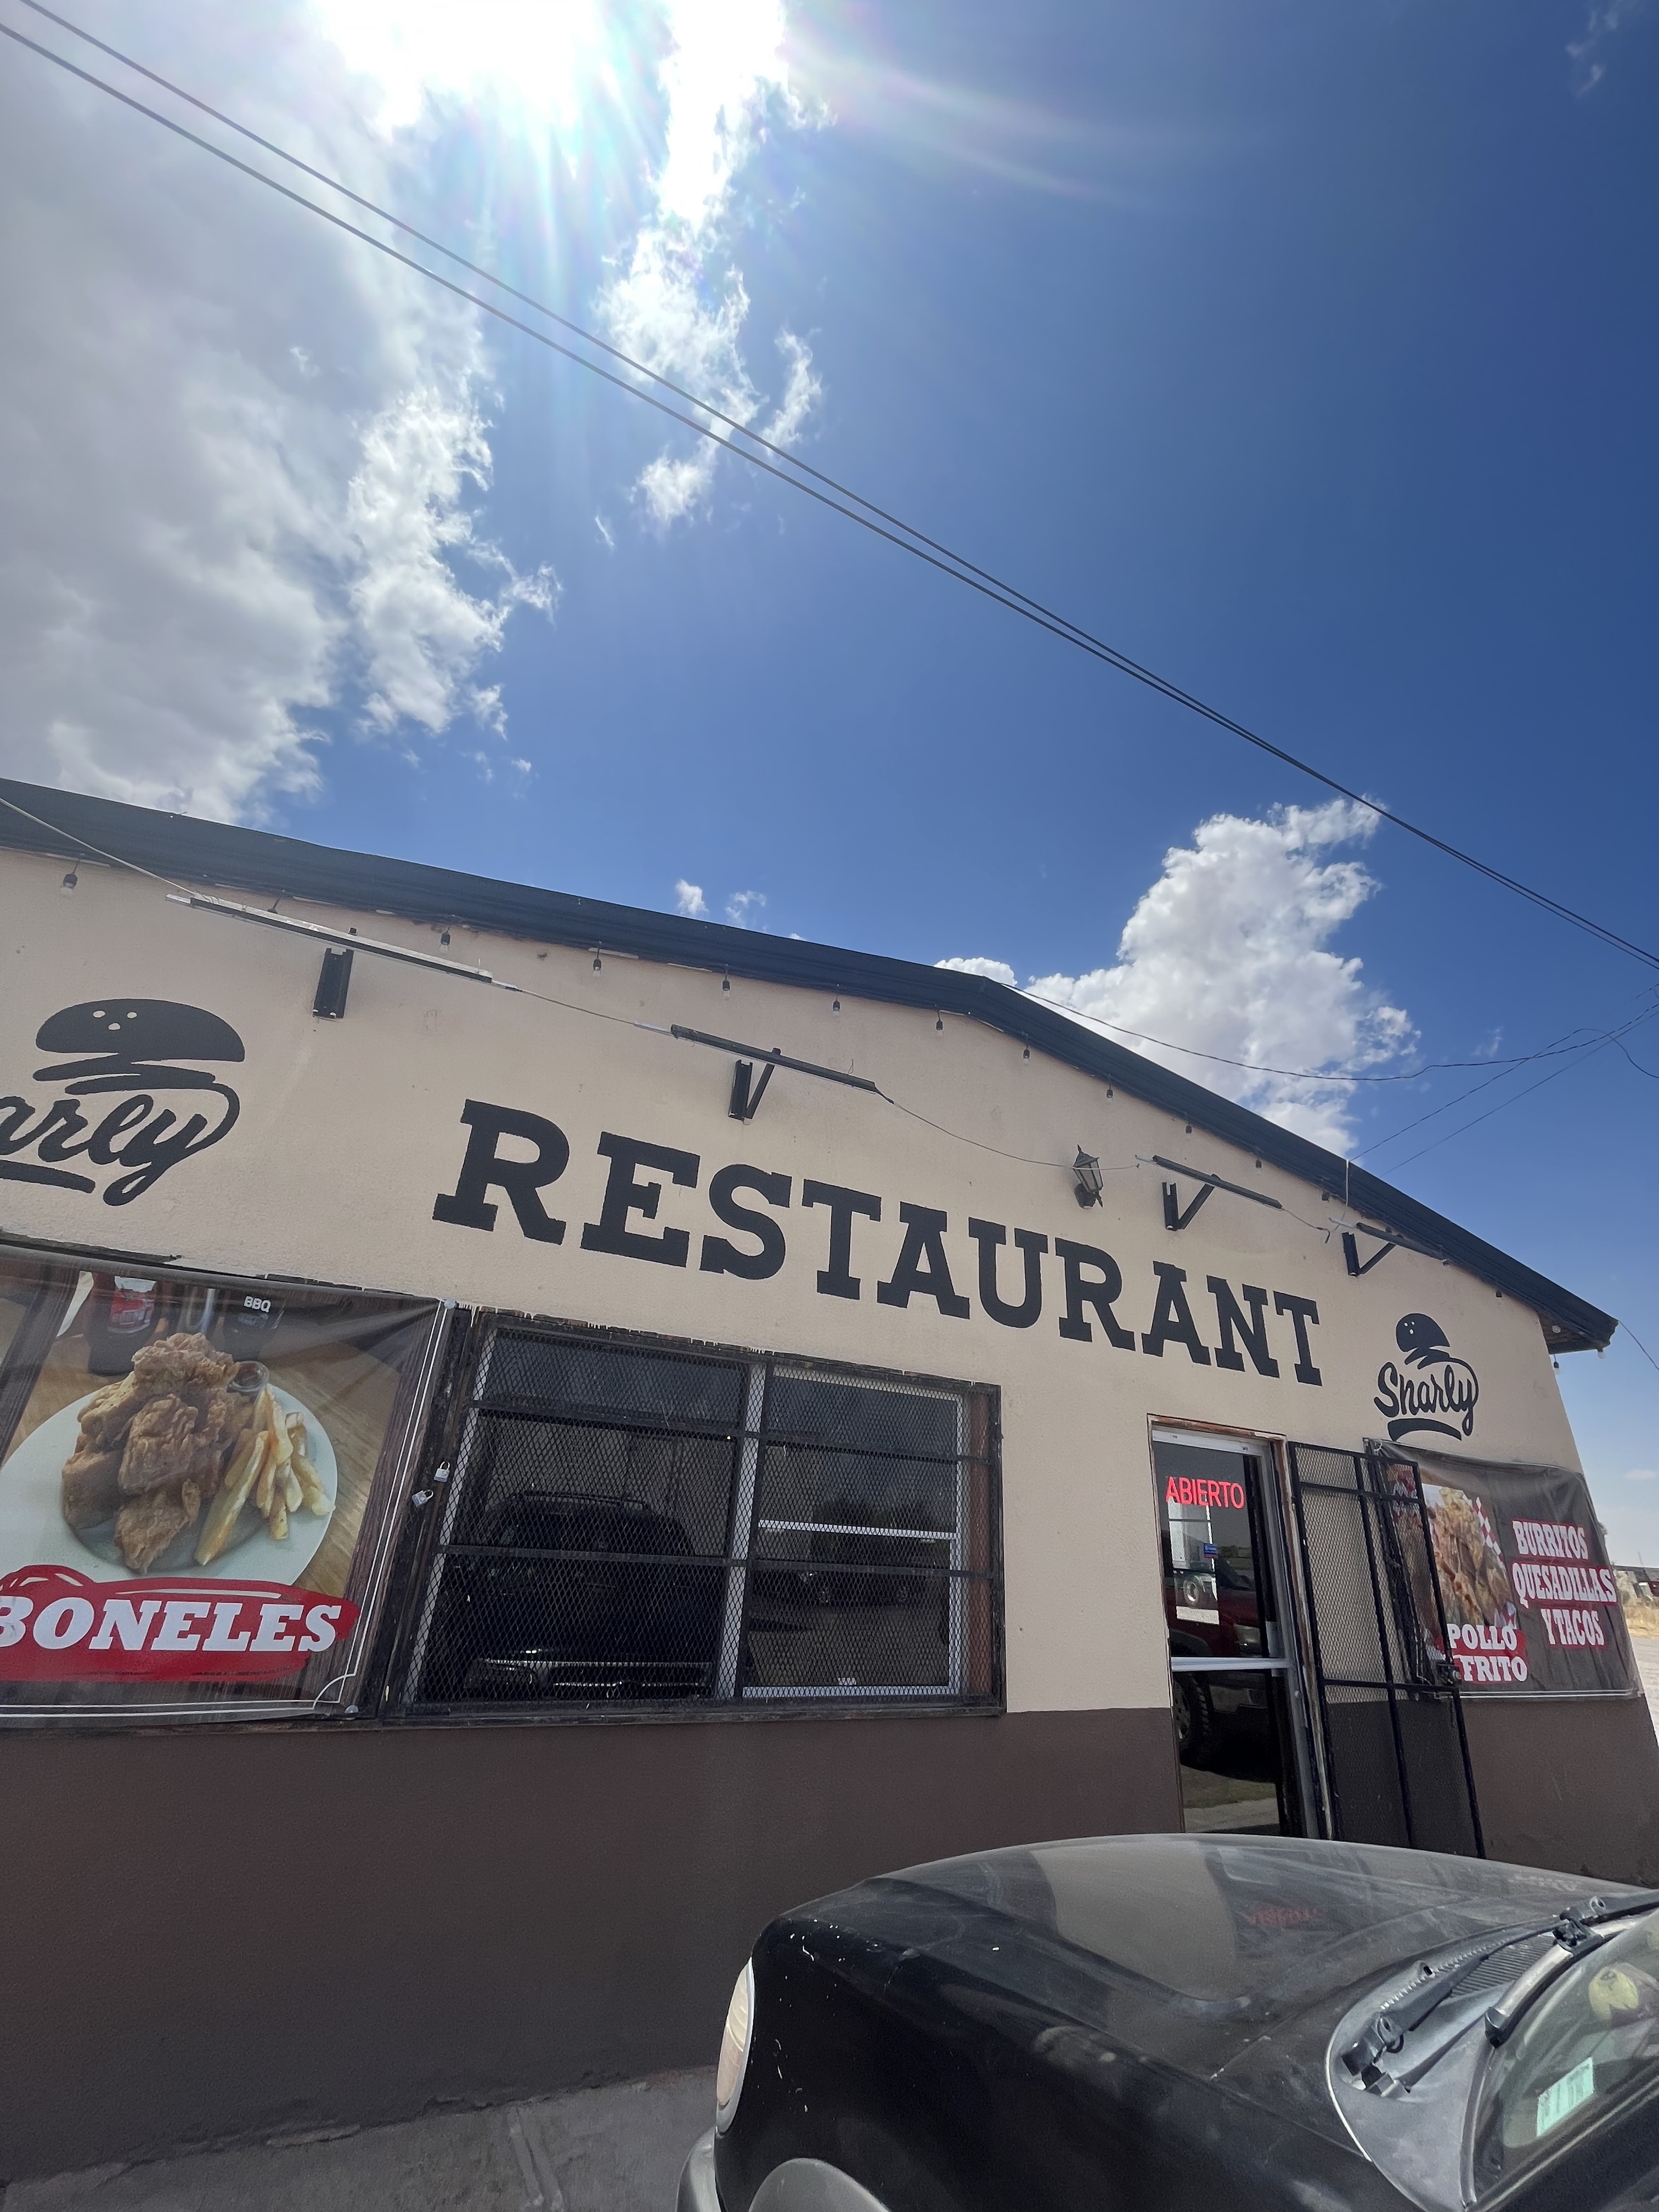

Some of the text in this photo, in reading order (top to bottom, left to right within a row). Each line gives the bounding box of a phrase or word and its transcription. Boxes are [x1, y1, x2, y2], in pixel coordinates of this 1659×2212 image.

[433, 1099, 1322, 1386] RESTAURANT
[244, 1296, 272, 1313] BBQ
[1165, 1476, 1244, 1509] ABIERTO
[1513, 1520, 1588, 1559] BURRITOS
[1513, 1563, 1617, 1609] QUESADILLAS
[0, 1596, 341, 1652] BONELES
[1447, 1623, 1517, 1651] POLLO
[1541, 1609, 1604, 1645] Y TACOS
[1460, 1656, 1527, 1681] FRITO
